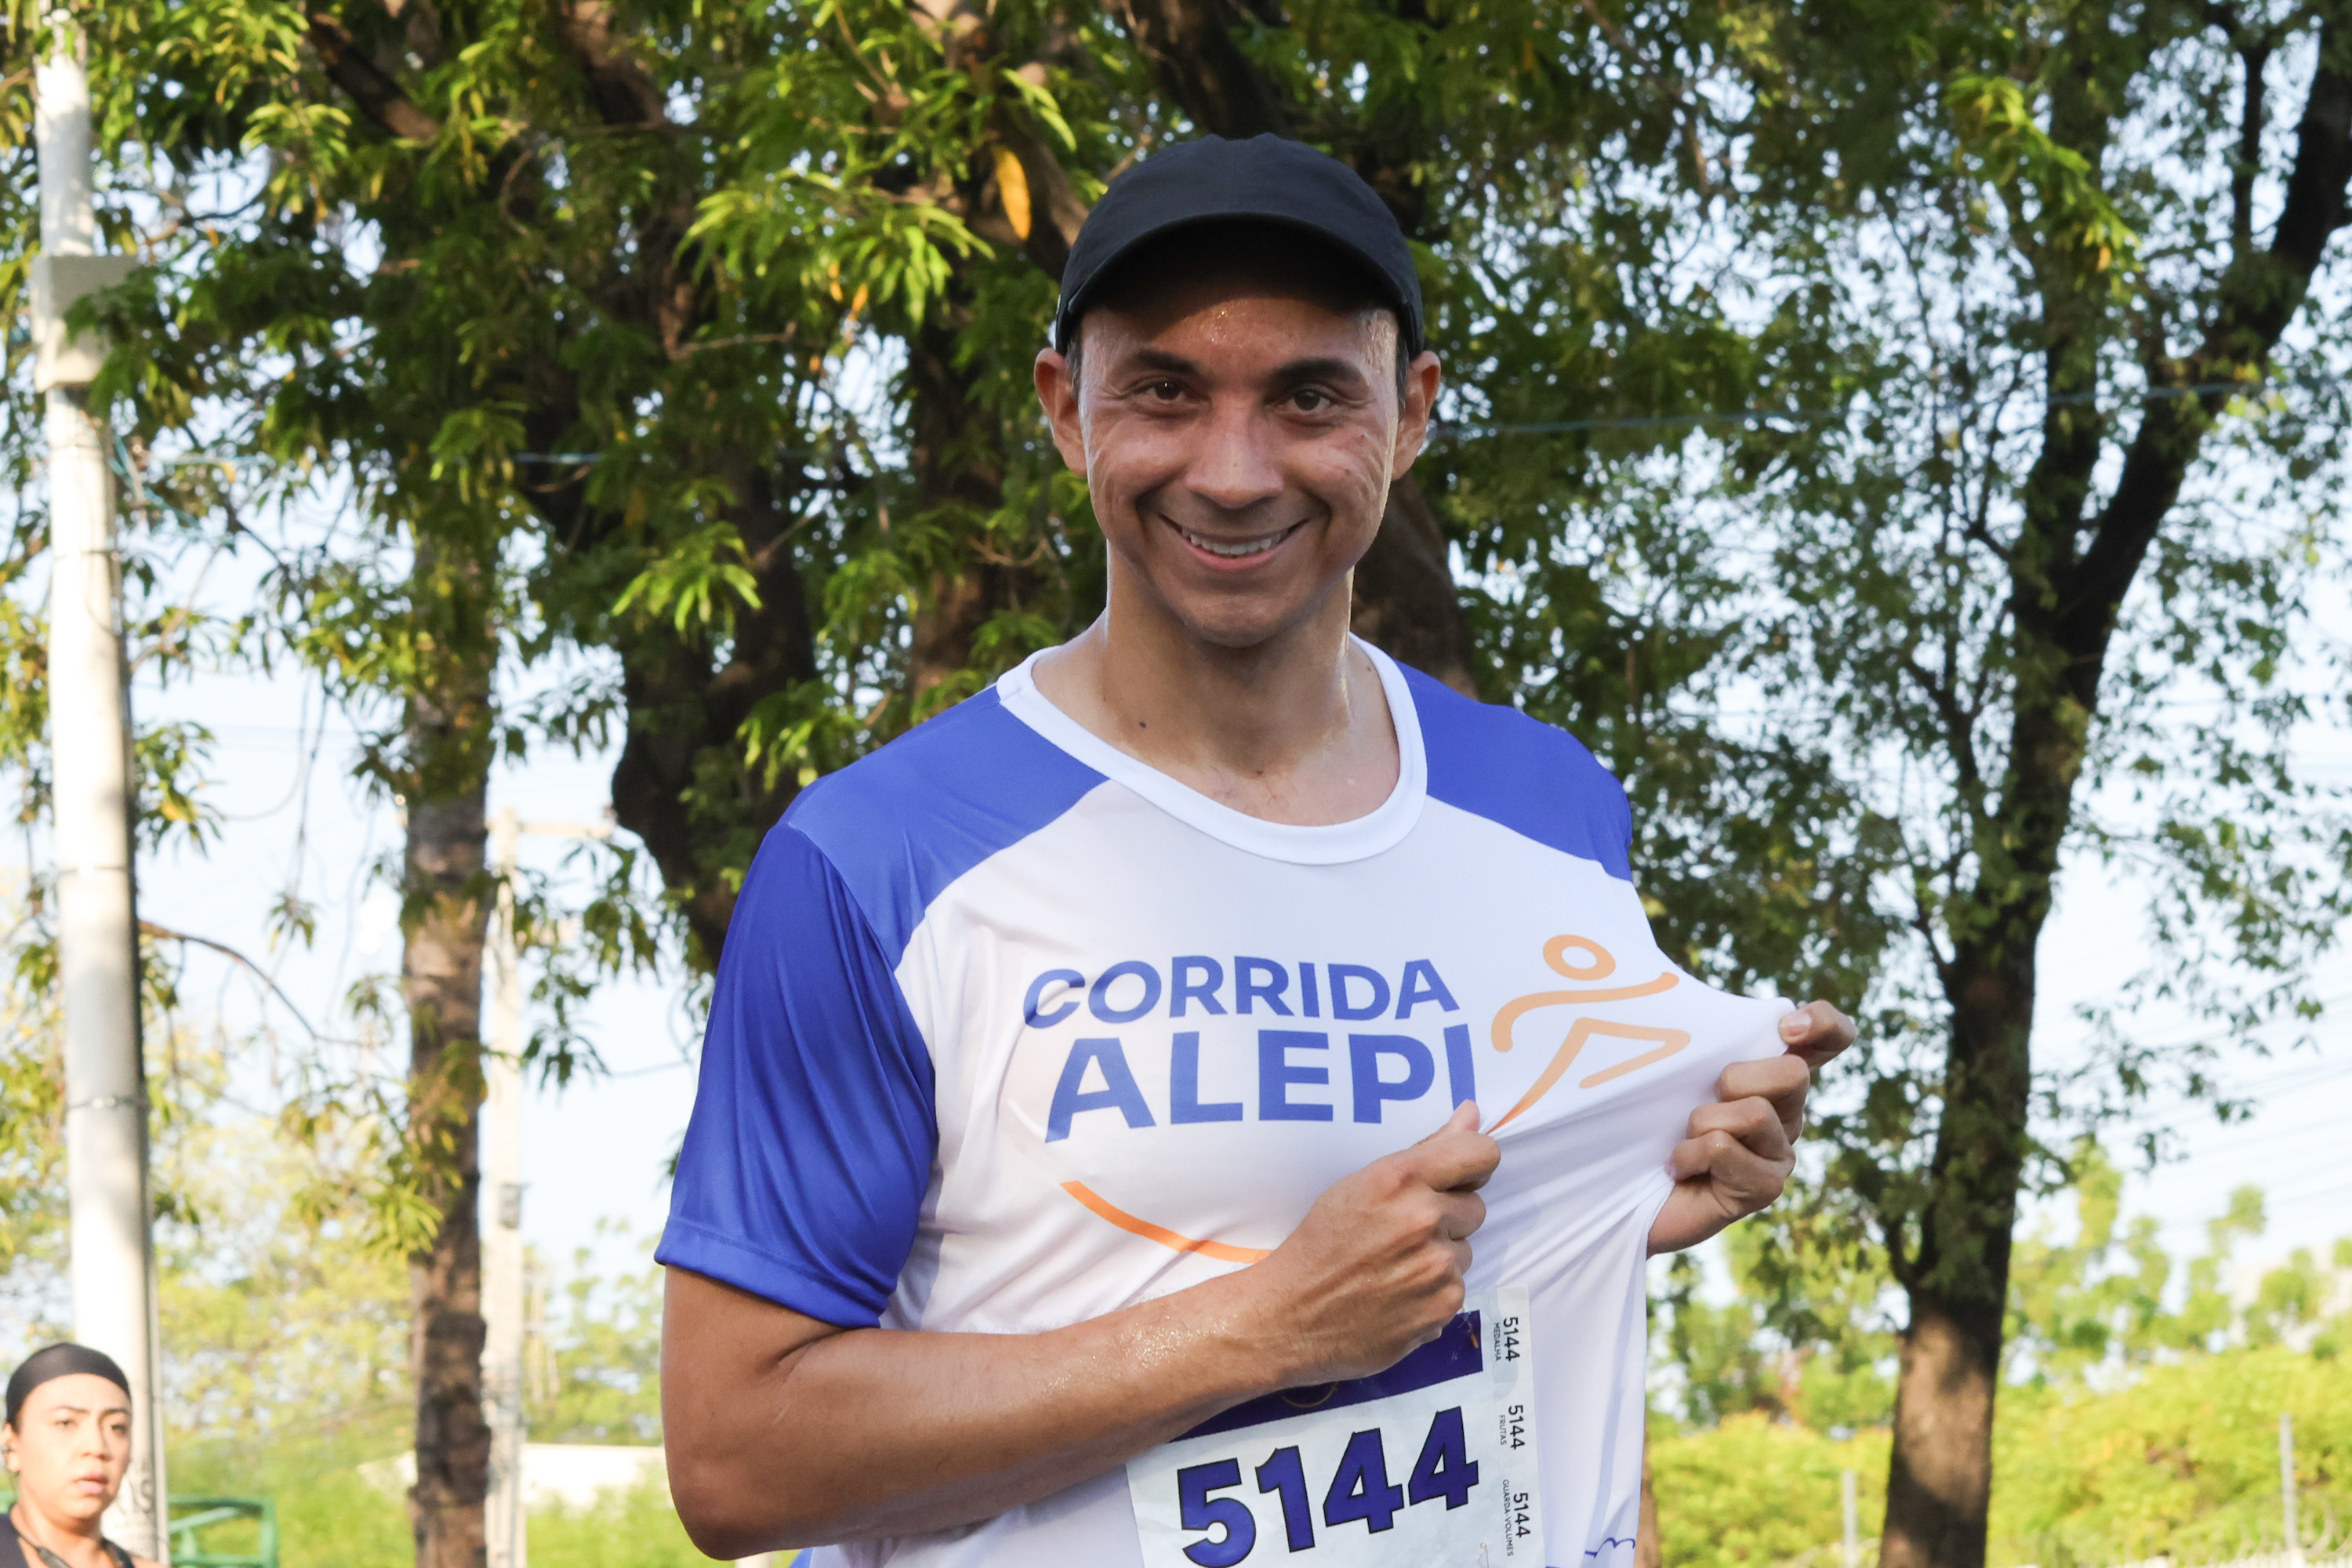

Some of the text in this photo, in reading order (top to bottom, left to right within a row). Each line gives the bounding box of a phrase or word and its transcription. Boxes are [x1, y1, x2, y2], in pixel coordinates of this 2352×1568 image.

[1022, 956, 1460, 1029] CORRIDA
[1045, 1023, 1476, 1143] ALEPI
[1503, 1316, 1520, 1362] 5144
[1498, 1414, 1507, 1446] FRUTAS
[1508, 1404, 1525, 1450] 5144
[1177, 1406, 1479, 1567] 5144
[1513, 1492, 1530, 1538] 5144
[1502, 1479, 1514, 1557] GUARDA-VOLUMES
